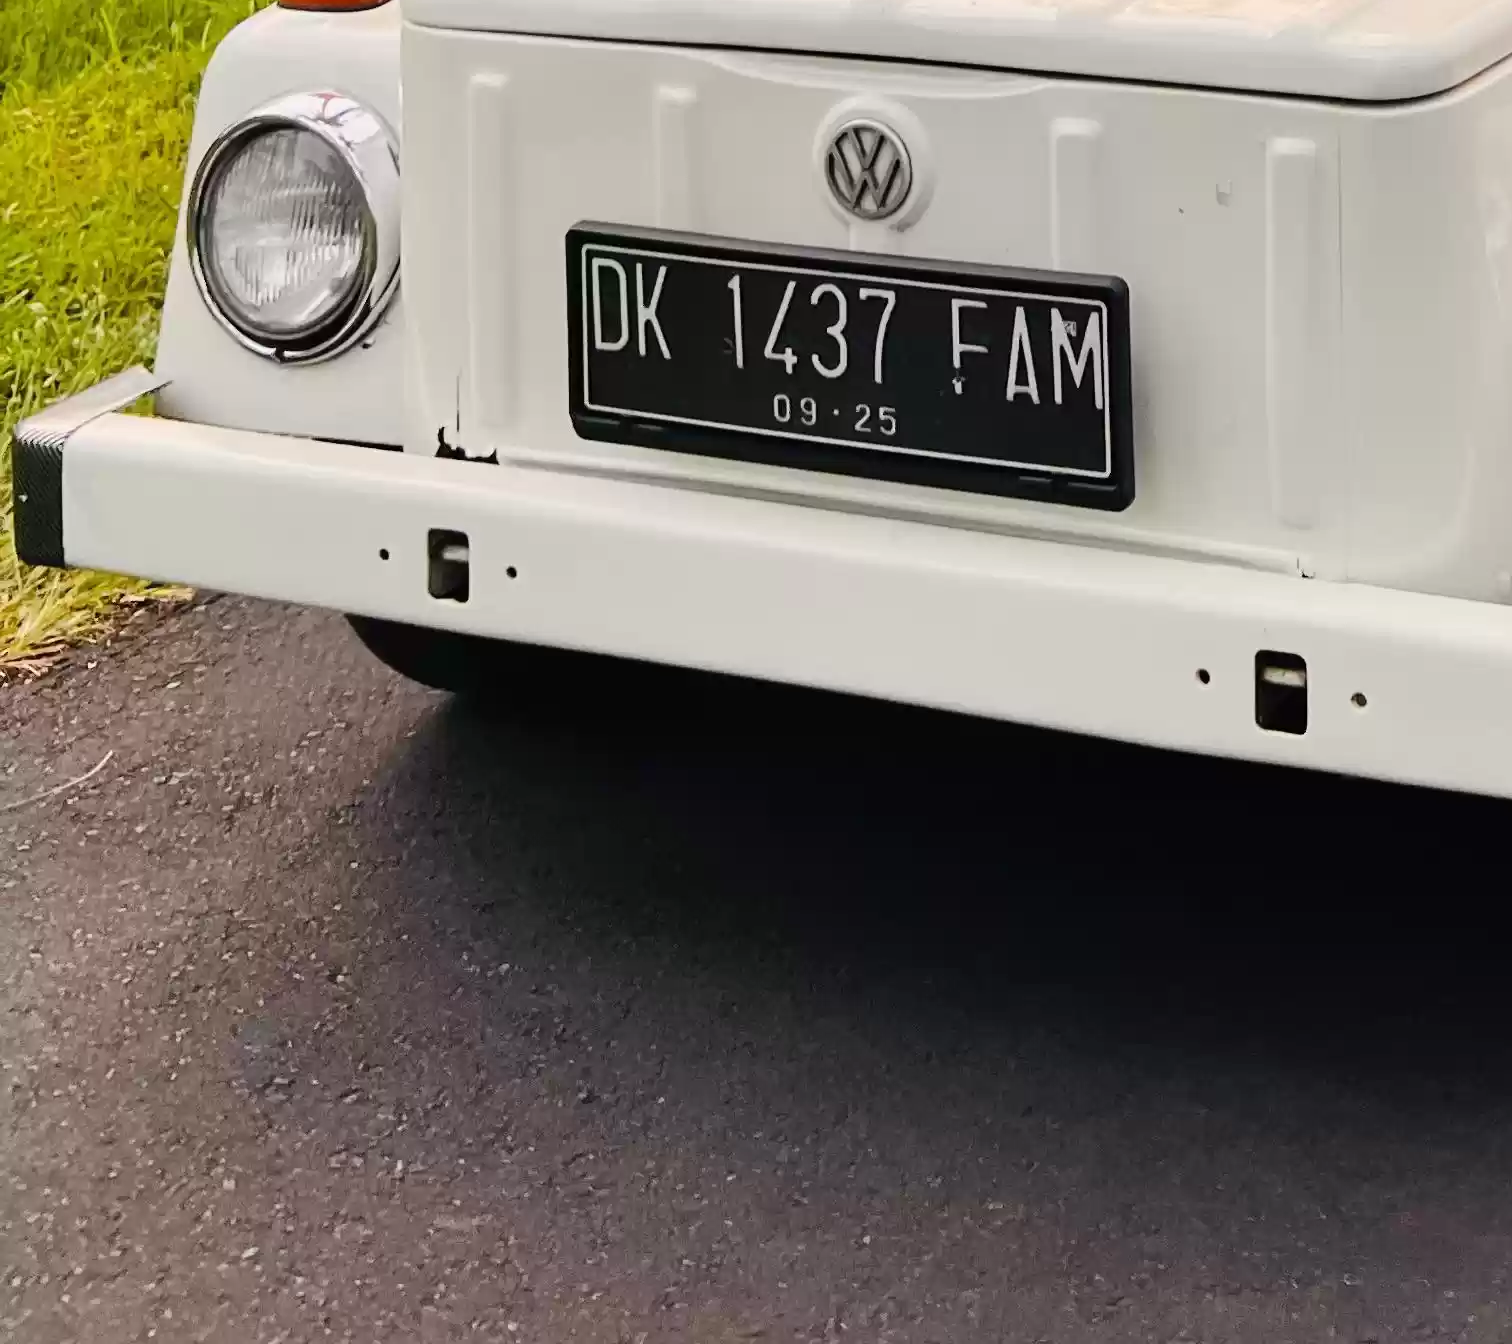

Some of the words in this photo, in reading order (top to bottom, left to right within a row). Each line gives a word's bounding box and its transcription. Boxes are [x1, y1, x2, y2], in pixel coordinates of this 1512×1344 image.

[826, 121, 908, 216] VW
[591, 258, 671, 360] DK
[727, 274, 896, 384] 1437
[951, 294, 1103, 410] FAM
